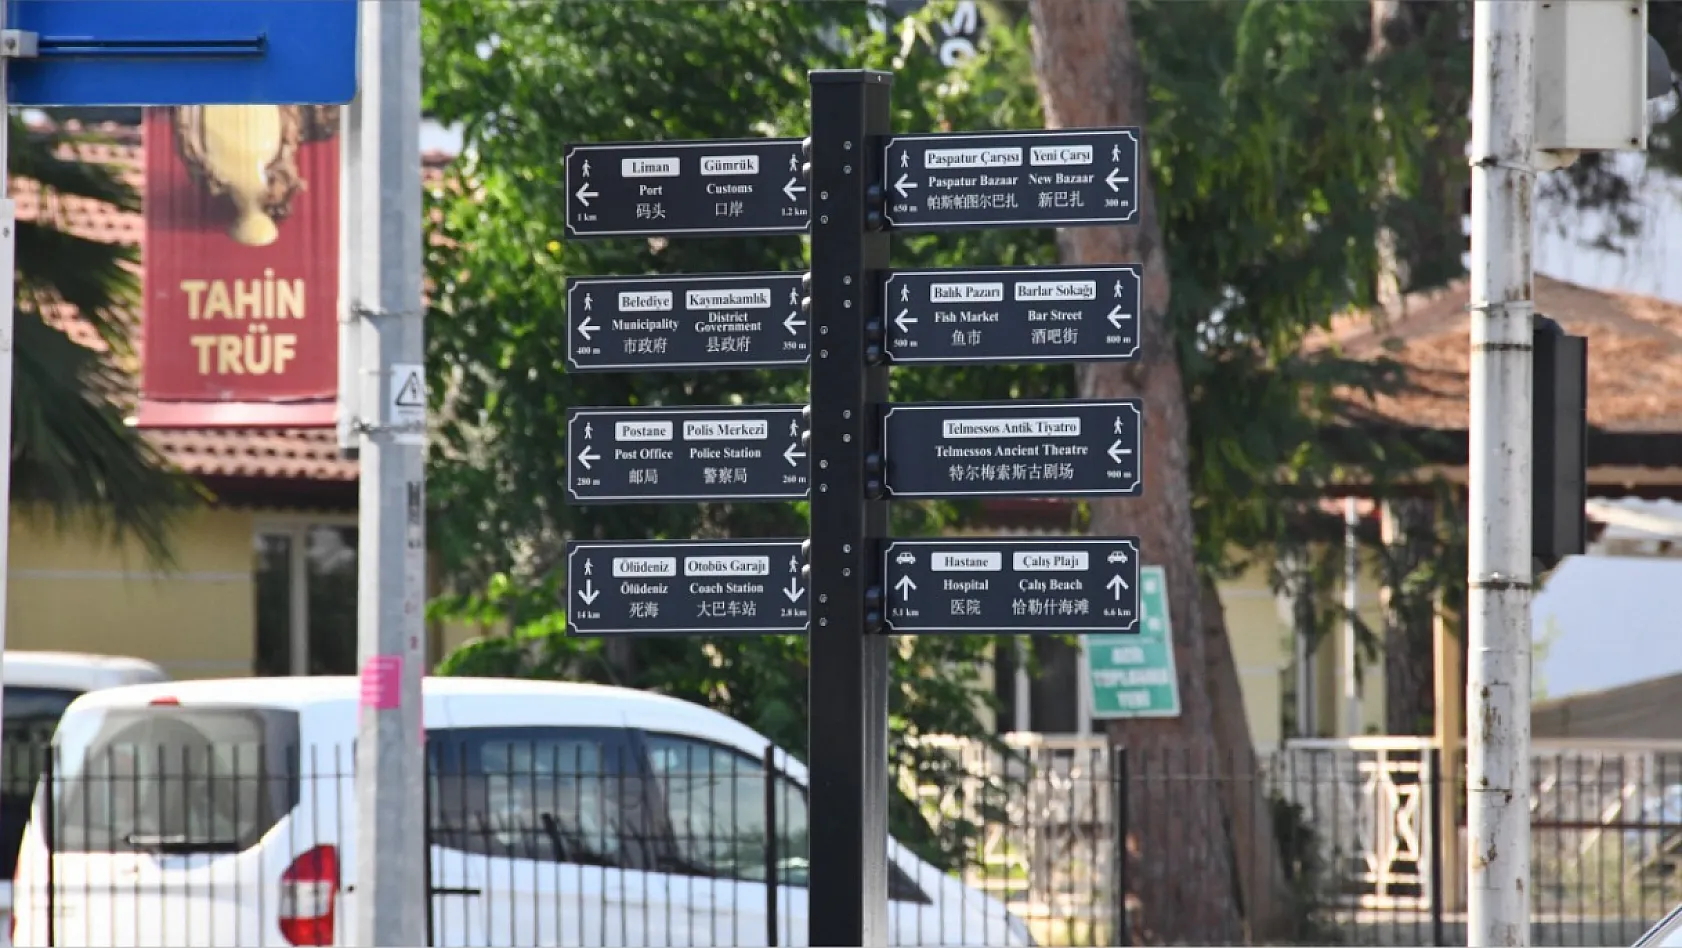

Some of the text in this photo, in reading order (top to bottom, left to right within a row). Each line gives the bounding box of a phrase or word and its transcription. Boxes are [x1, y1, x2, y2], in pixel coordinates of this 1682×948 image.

[928, 152, 1020, 165] Paspatur Çarşısı
[1033, 149, 1090, 162] Yeni Çarşı
[632, 161, 670, 173] Liman
[704, 158, 754, 172] Gümrük
[928, 174, 1018, 189] Paspatur Bazaar
[1028, 173, 1094, 184] New Bazaar
[639, 184, 662, 196] Port
[706, 182, 753, 194] Customs
[1038, 191, 1084, 208] 新巴扎
[636, 203, 666, 219] 码头
[715, 201, 743, 217] 口岸
[781, 207, 807, 216] 1.2 km
[583, 213, 597, 221] km
[180, 268, 305, 319] TAHİN
[934, 286, 1000, 298] Balık Pazarı
[1018, 284, 1093, 298] Barlar Sokağı
[622, 296, 670, 309] Belediye
[709, 312, 748, 322] District
[934, 311, 999, 323] Fish Market
[1028, 310, 1082, 321] Bar Street
[612, 318, 679, 332] Municipality
[695, 321, 762, 333] Government
[952, 329, 981, 346] 鱼市
[1032, 328, 1078, 344] 酒吧街
[190, 323, 297, 374] TRÜF
[623, 337, 667, 354] 市政府
[706, 336, 751, 352] 县政府
[622, 425, 666, 437] Postane
[687, 423, 764, 436] Polis Merkezi
[948, 421, 1076, 435] Telmessos Antik Tiyatro
[615, 448, 673, 460] Post Office
[690, 447, 761, 459] Police Station
[936, 444, 1088, 457] Telmessos Ancient Theatre
[629, 468, 658, 485] 邮局
[703, 467, 746, 484] 警察局
[620, 559, 670, 572] Ölüdeniz
[688, 559, 766, 574] Otobüs Garajı
[945, 556, 988, 567] Hastane
[1023, 555, 1079, 569] Çalış Plajı
[621, 581, 668, 594] Ölüdeniz
[690, 582, 764, 594] Coach Station
[943, 579, 988, 593] Hospital
[1019, 579, 1082, 592] Çalış Beach
[629, 602, 659, 619] 死海
[697, 600, 756, 617] 大巴车站
[794, 608, 807, 617] km
[906, 608, 919, 616] km
[951, 599, 980, 615] 医院
[1117, 607, 1131, 616] km
[577, 610, 600, 619] 14 km
